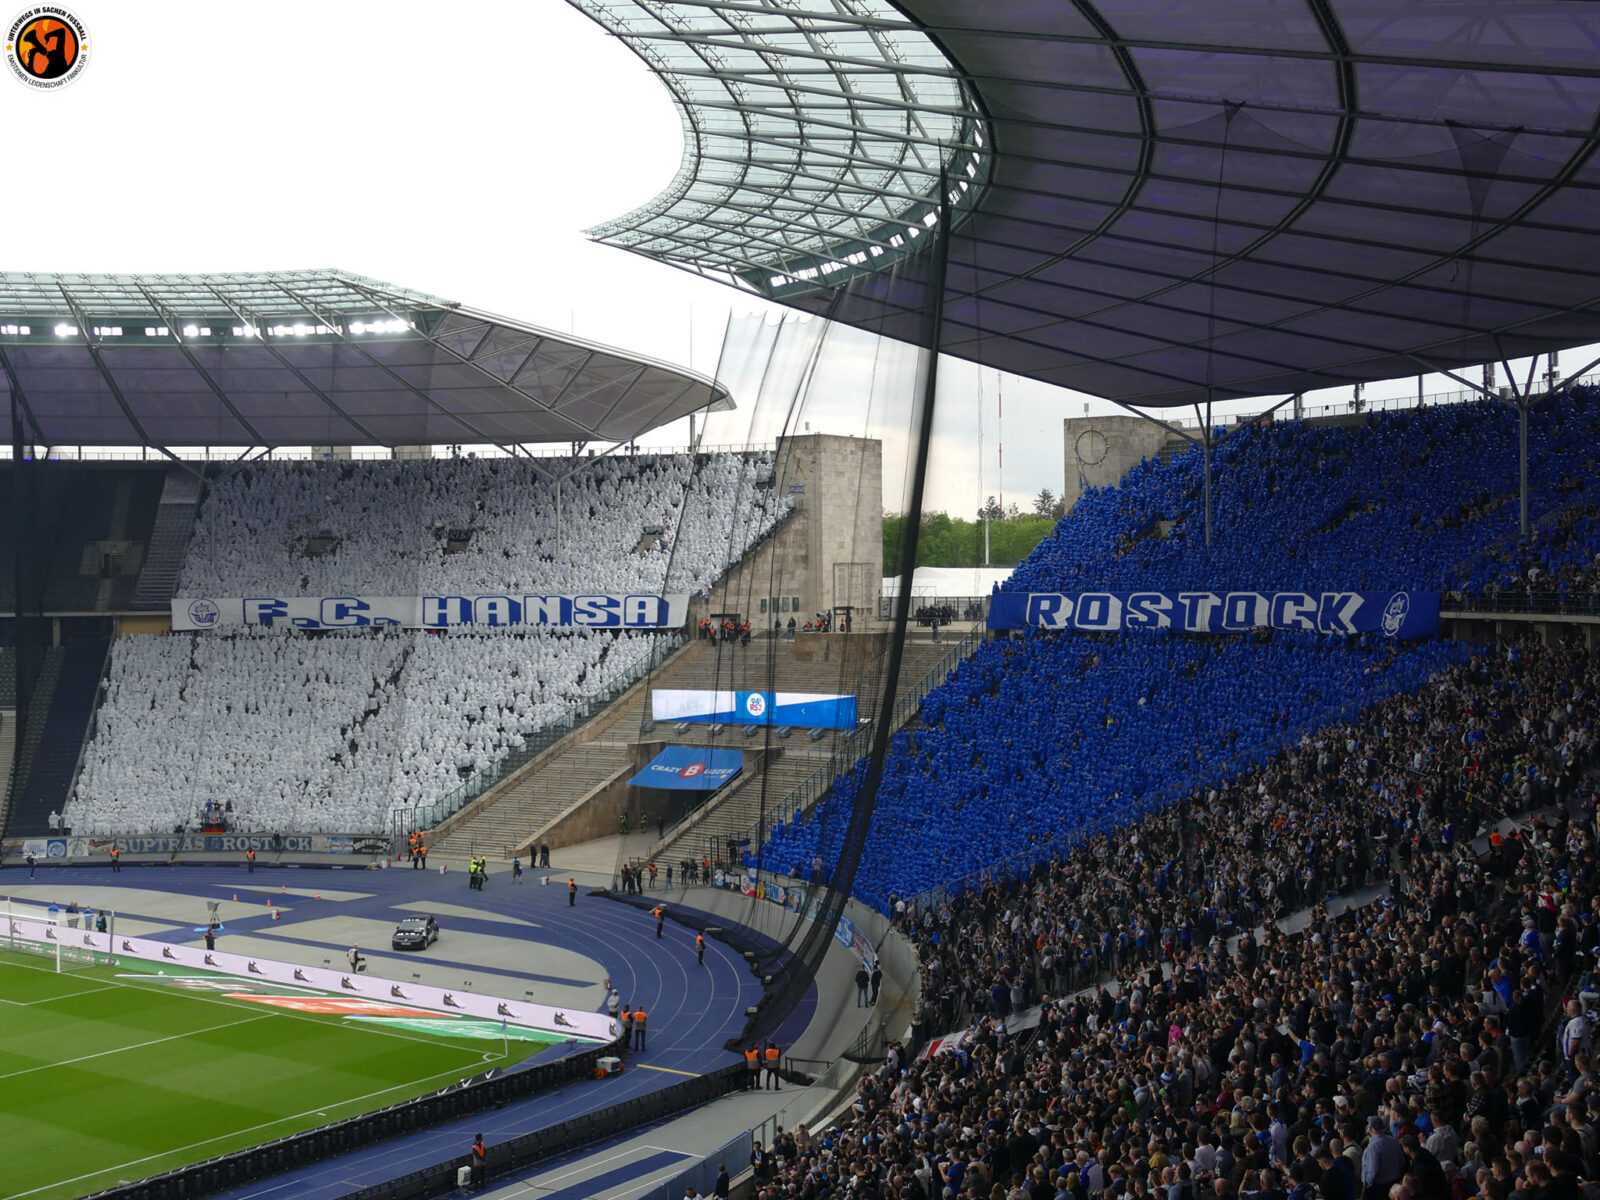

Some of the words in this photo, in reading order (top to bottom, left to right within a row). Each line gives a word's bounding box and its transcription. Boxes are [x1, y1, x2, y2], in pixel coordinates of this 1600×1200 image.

[243, 597, 400, 628] F.C.
[423, 595, 669, 627] HANSA
[1027, 593, 1366, 635] ROSTOCK
